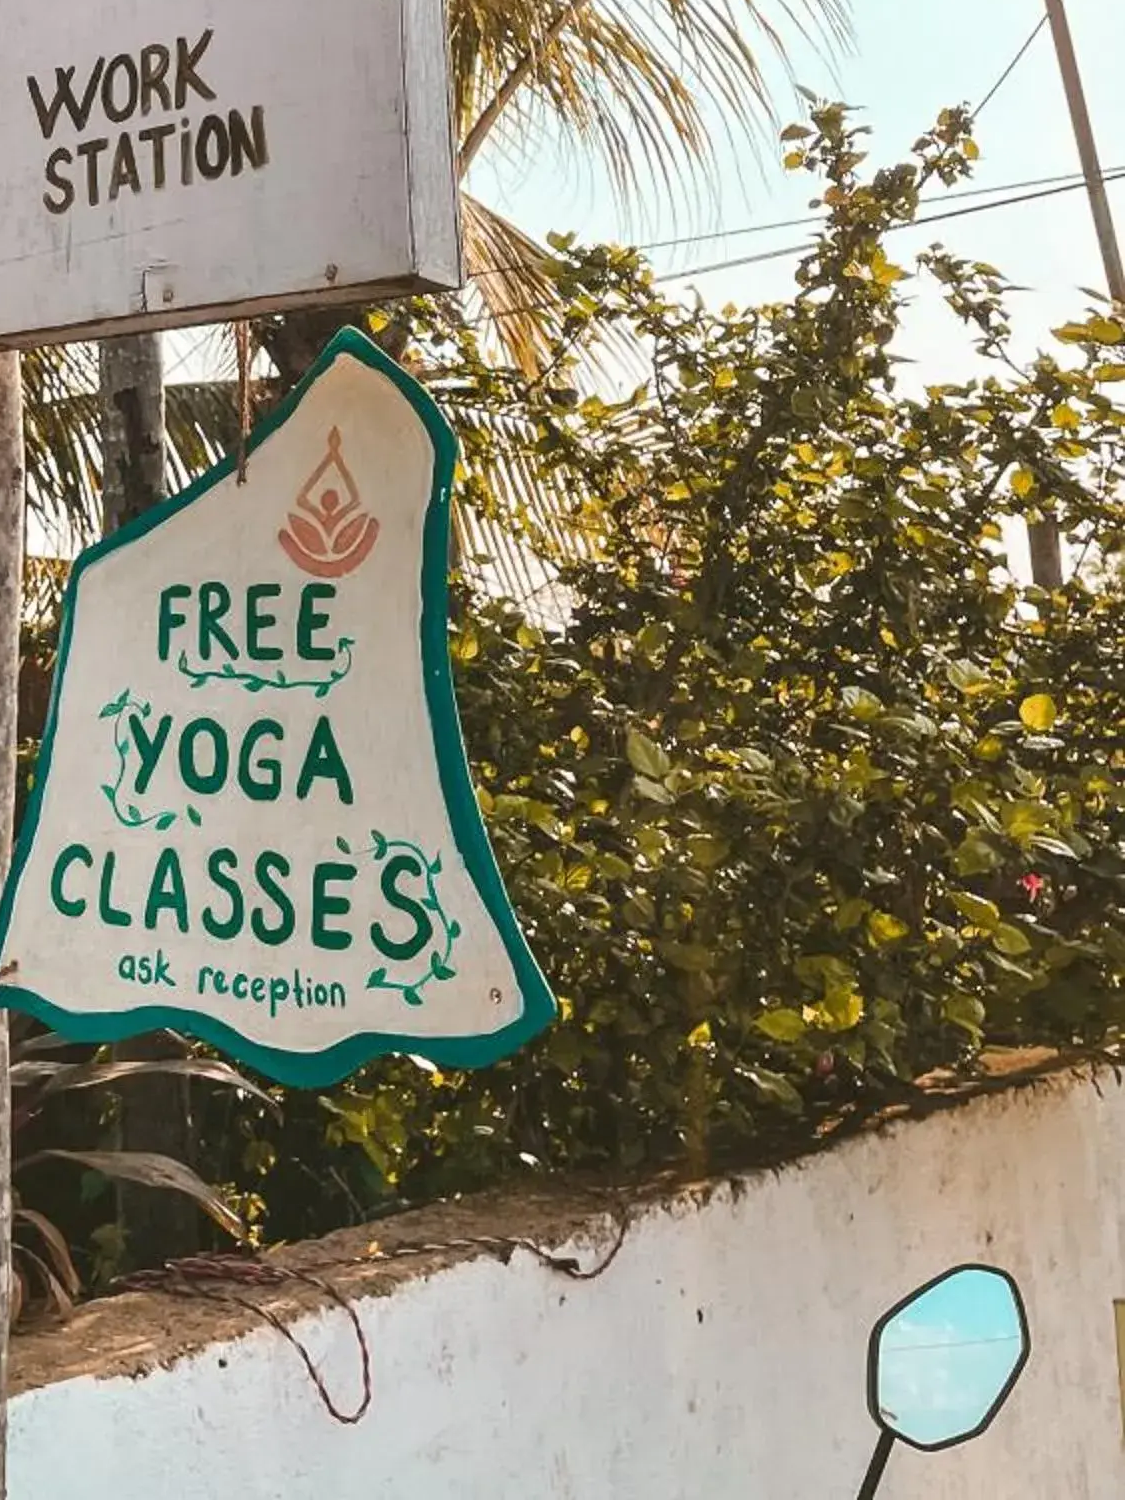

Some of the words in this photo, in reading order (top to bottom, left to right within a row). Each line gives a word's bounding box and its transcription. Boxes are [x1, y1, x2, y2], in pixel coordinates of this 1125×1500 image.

[27, 29, 217, 139] WORK
[157, 581, 337, 660] FREE
[129, 714, 354, 804] YOGA
[50, 844, 433, 961] CLASSES
[118, 950, 176, 986] ask
[198, 965, 346, 1017] reception
